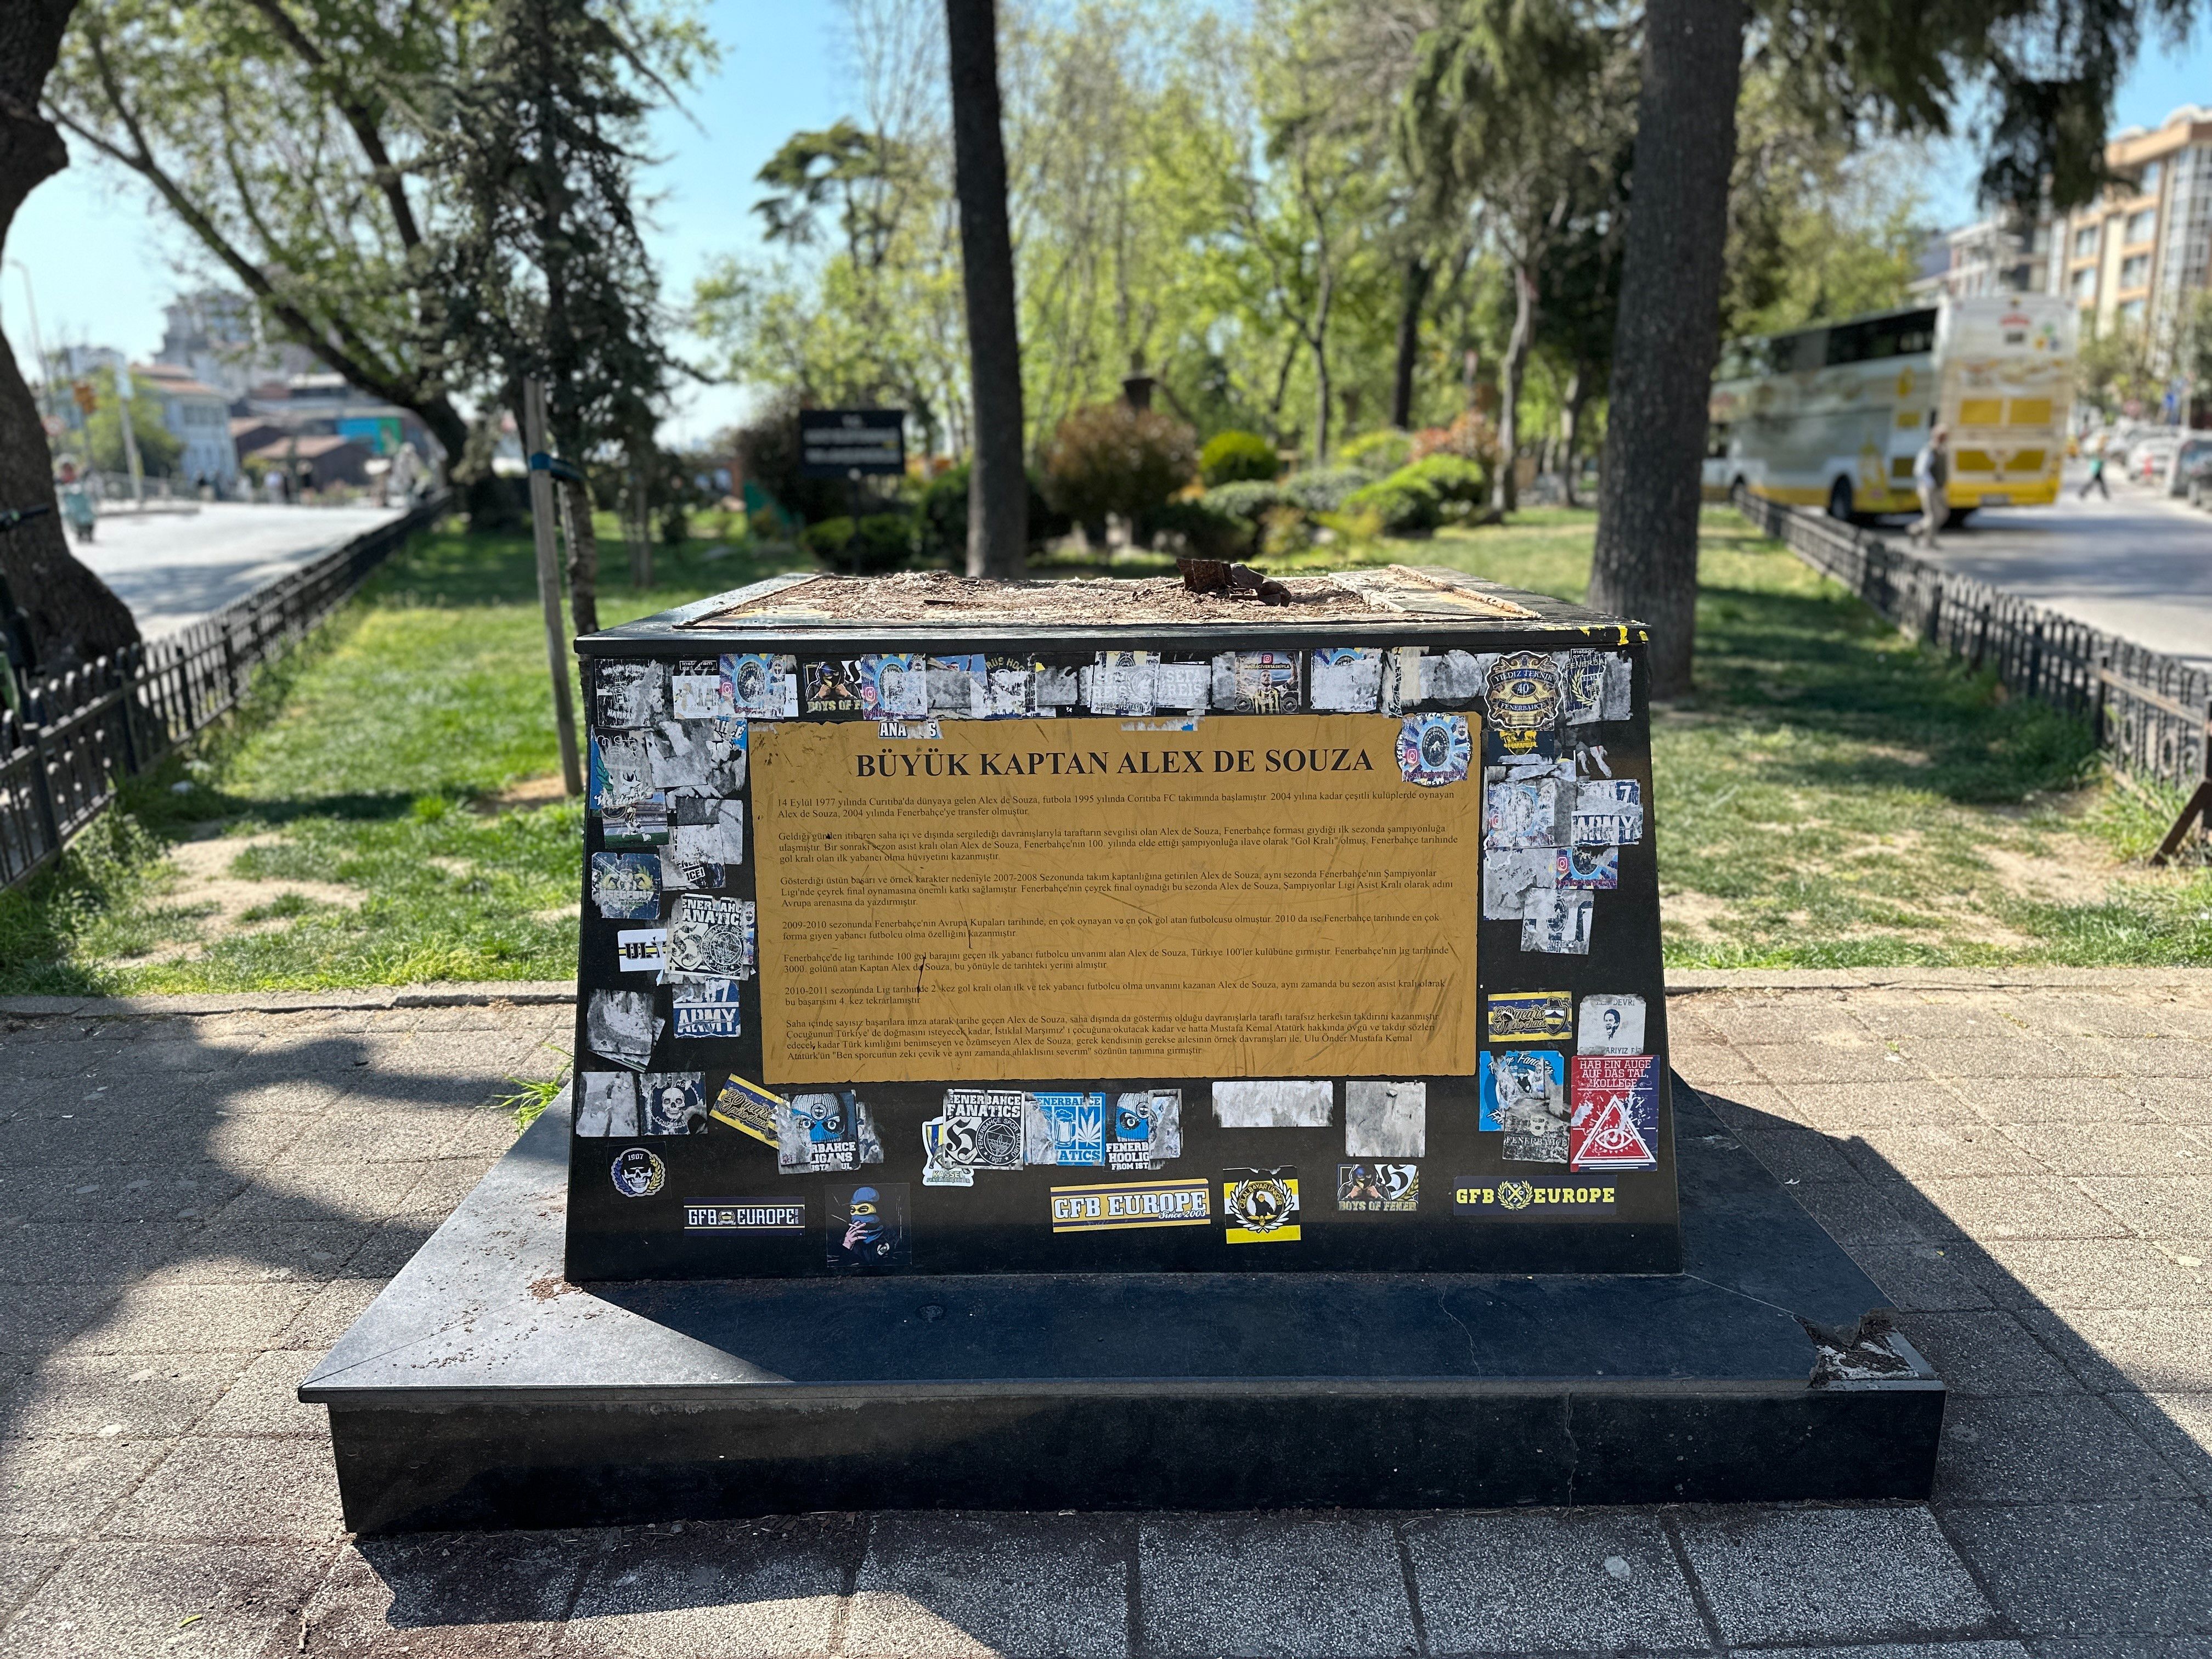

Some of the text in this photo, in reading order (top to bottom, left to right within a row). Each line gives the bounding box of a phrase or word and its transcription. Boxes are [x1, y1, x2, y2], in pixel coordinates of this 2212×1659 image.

[1517, 683, 1529, 694] 40
[855, 748, 1375, 777] BÜYÜK KAPTAN ALEX DE SOUZA
[791, 791, 1454, 808] Eylül dünyaya gelen futbola kulüplerde oynayan
[777, 807, 989, 818] Alex 2004 transfer
[879, 825, 1385, 839] saha olan Alex Fenerbahçe sezonda
[960, 840, 979, 849] Alex
[1139, 838, 1155, 847] elde
[1263, 837, 1288, 846] olarak
[1372, 836, 1418, 847] Fenerbahçe
[780, 853, 834, 864] gol olan
[827, 870, 1316, 884] üstün örnek karakter Sezonunda Alex sezonda
[817, 880, 1430, 897] çeyrek çeyrek sezonda Alex olarak
[782, 898, 811, 909] Avrupa
[830, 913, 1372, 929] sezonunda Avrupa oynayan futbolcusu Fenerbahçe
[783, 929, 925, 940] forma futbolcu olma
[963, 947, 1293, 961] geçen futbolcu alan Alex kulübüne
[810, 961, 1000, 973] golünü atan Alex yönüyle
[831, 978, 1446, 993] sezonunda futbolcu kazanan zamanda olarak
[850, 995, 864, 1004] kez
[787, 1014, 1202, 1027] Saha atarak Alex saha olduğu
[787, 1024, 1305, 1040] Çocuğunun çocuğuna okutacak Mustafa Atatürk
[817, 1034, 1383, 1048] kadar özümseyen gerek gerekse Mustafa
[855, 1046, 1127, 1060] sporcunun zamanda sözünün
[1579, 1059, 1652, 1069] HAB EIN AUGE
[1582, 1069, 1649, 1079] AUF DAS TAL,
[1593, 1079, 1638, 1088] KOLLEGE
[946, 1104, 1021, 1118] FANATICS
[1111, 1161, 1134, 1170] FROM
[933, 1170, 966, 1179] KASSEL
[1456, 1187, 1615, 1204] GFB EUROPE
[1053, 1191, 1207, 1220] GFB EUROPE
[1338, 1200, 1418, 1211] BOYS OF FENER
[688, 1209, 717, 1225] GFB
[737, 1209, 795, 1224] EUROPE
[1157, 1208, 1207, 1220] Since 2003
